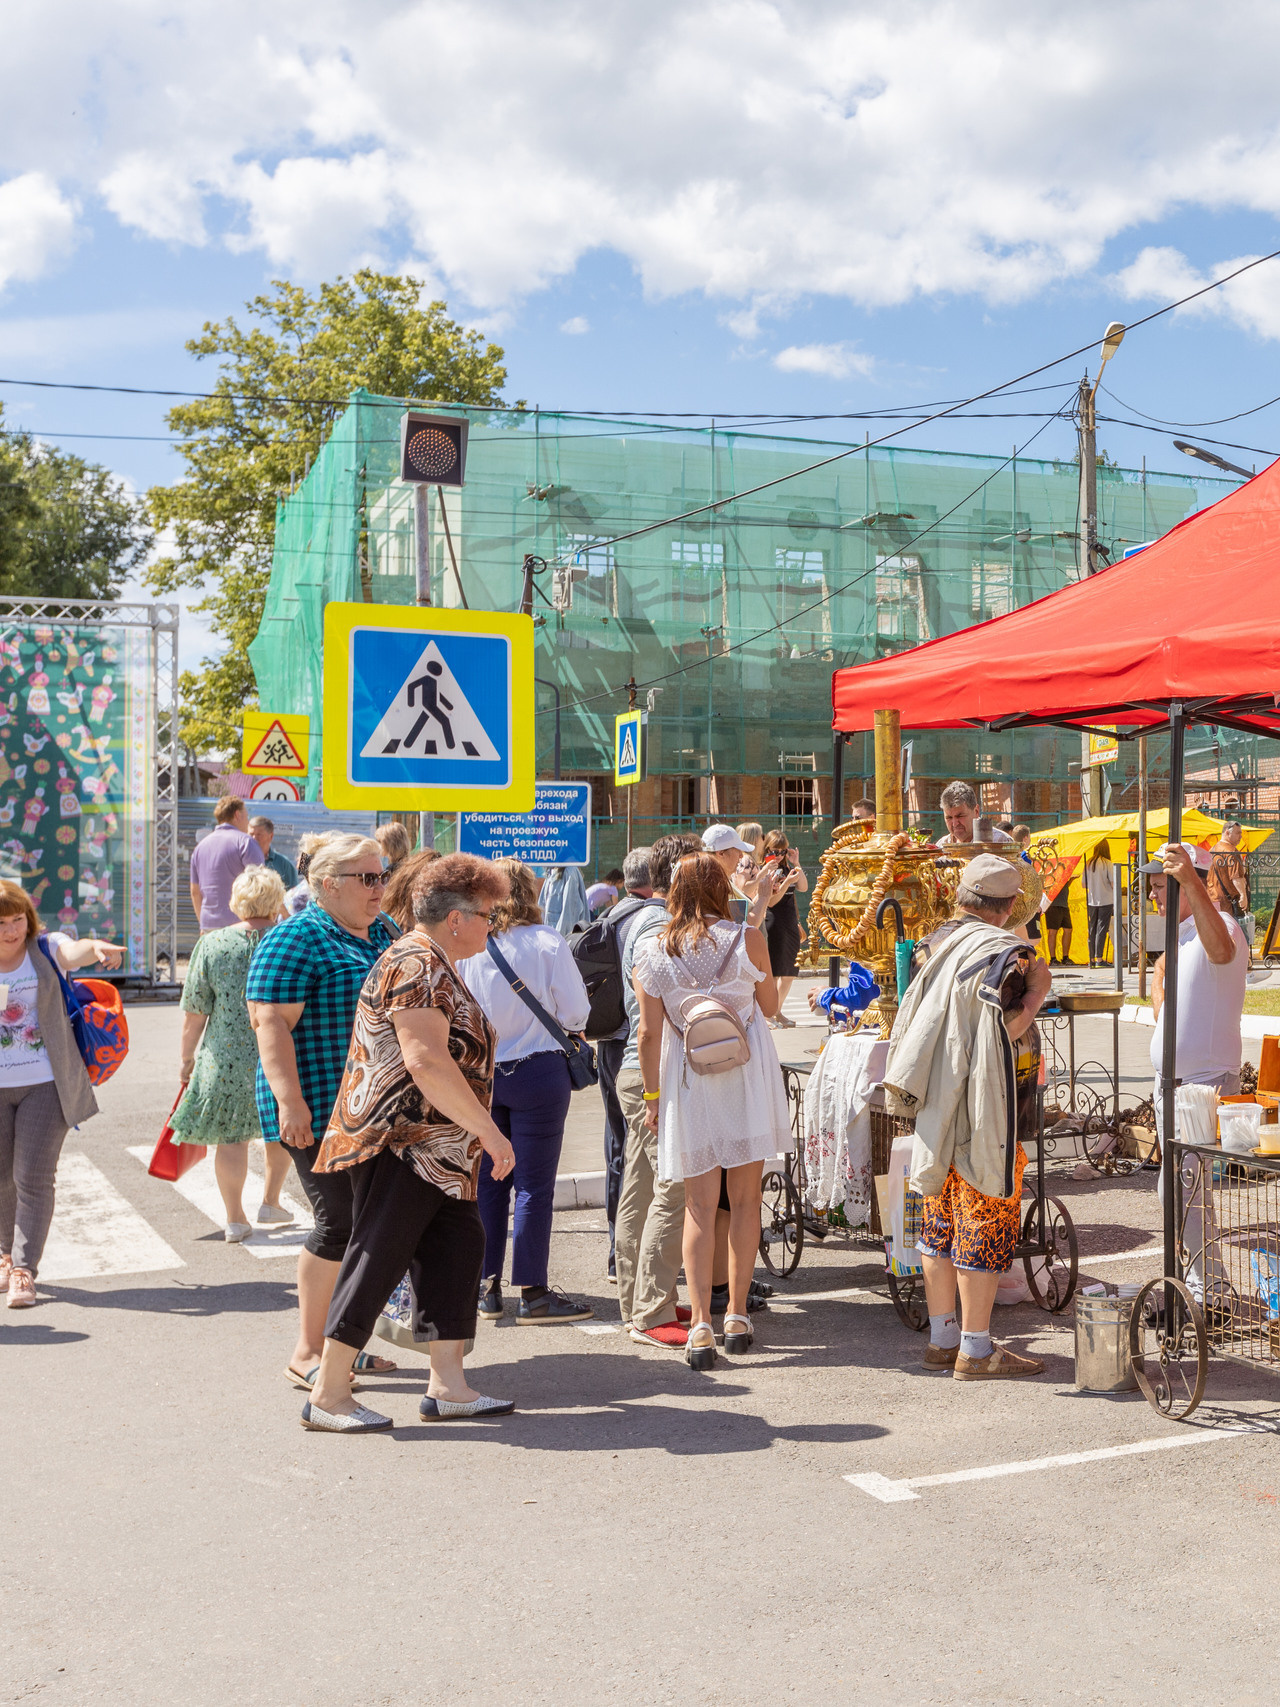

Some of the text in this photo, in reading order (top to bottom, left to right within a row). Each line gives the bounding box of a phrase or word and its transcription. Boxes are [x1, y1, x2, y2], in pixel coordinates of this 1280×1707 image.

[535, 790, 578, 799] ерехода
[465, 813, 583, 823] убедиться, что выход
[490, 827, 559, 837] на проезжую
[480, 838, 568, 847] часть безопасен
